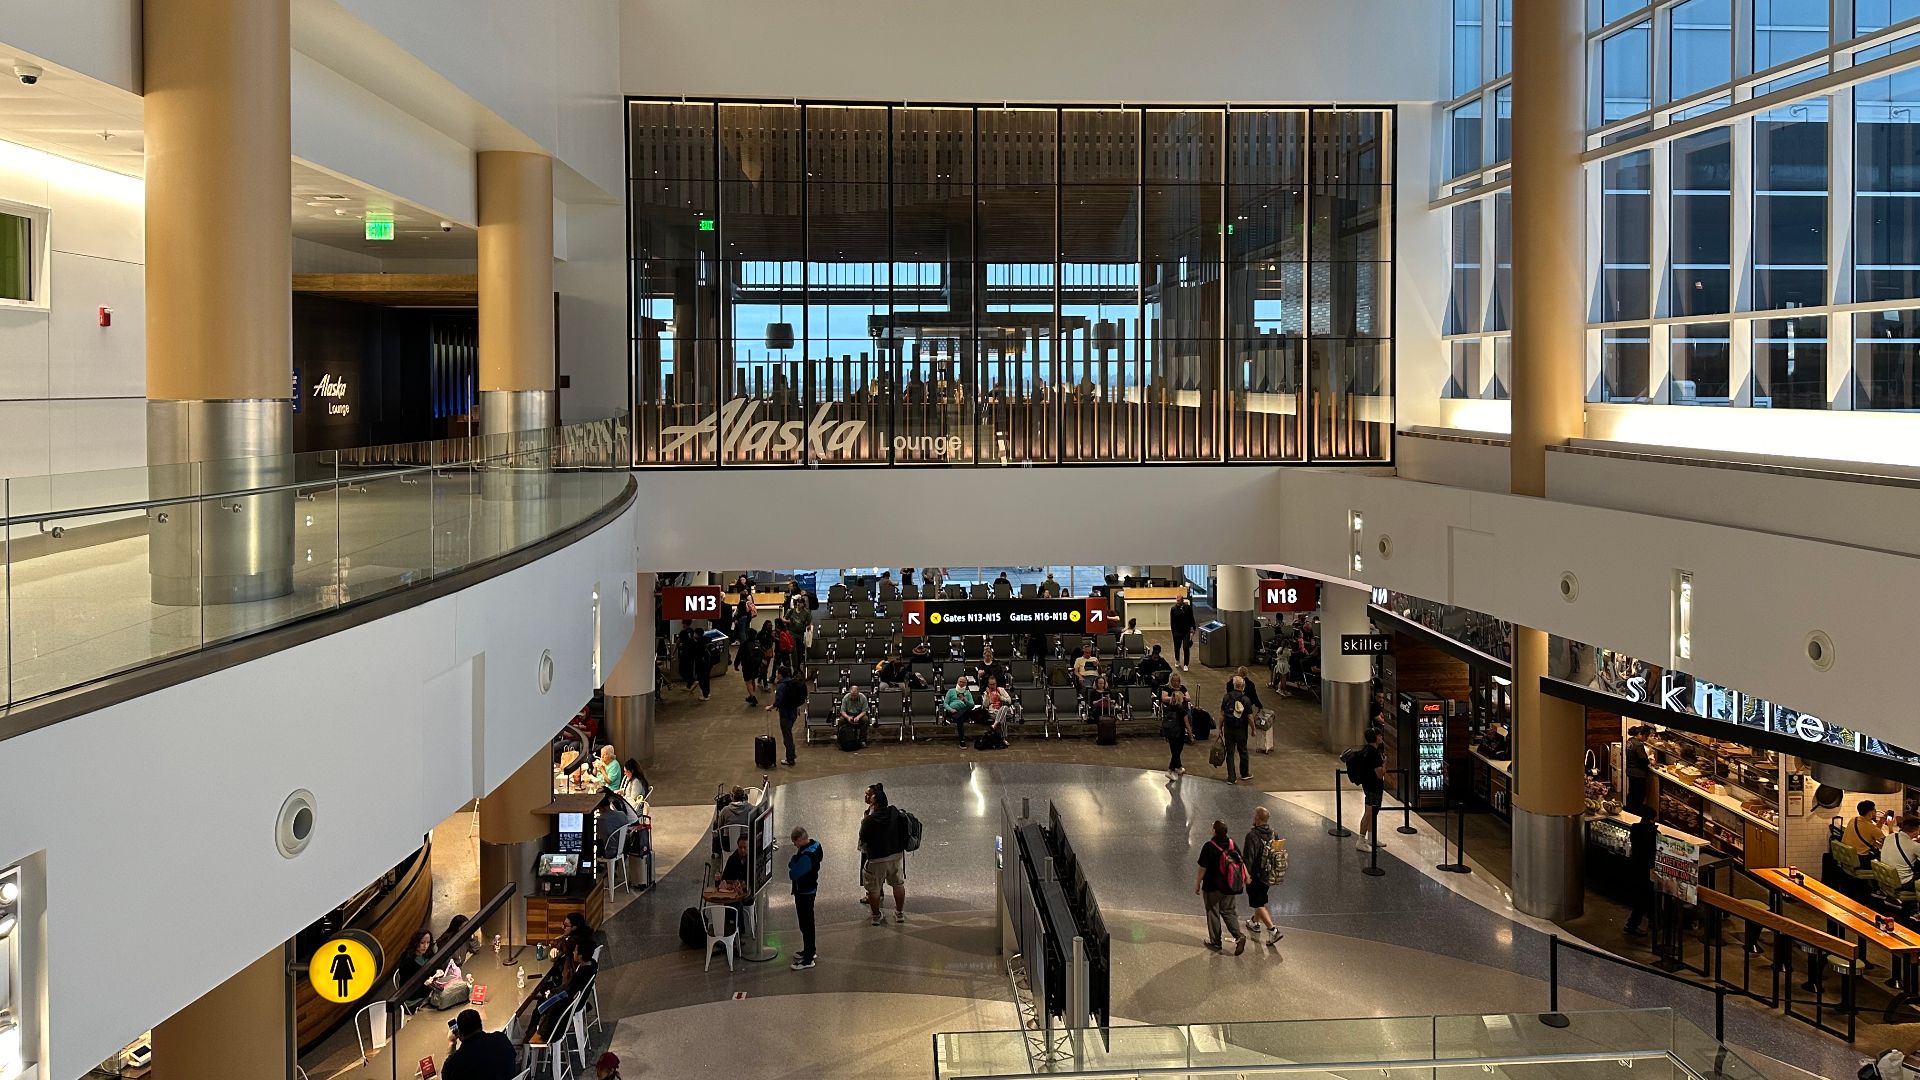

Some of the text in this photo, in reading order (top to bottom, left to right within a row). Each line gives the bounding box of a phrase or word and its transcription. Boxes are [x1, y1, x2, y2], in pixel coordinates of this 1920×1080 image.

[313, 373, 347, 399] Alaska
[328, 402, 350, 416] Lounge
[661, 397, 866, 460] Alaska
[879, 431, 962, 456] Lounge
[685, 595, 717, 612] N13
[1267, 588, 1298, 604] N18
[943, 613, 1001, 623] Gates N13-N15
[1009, 612, 1068, 622] Gates N16-N18
[1343, 638, 1389, 651] skillet
